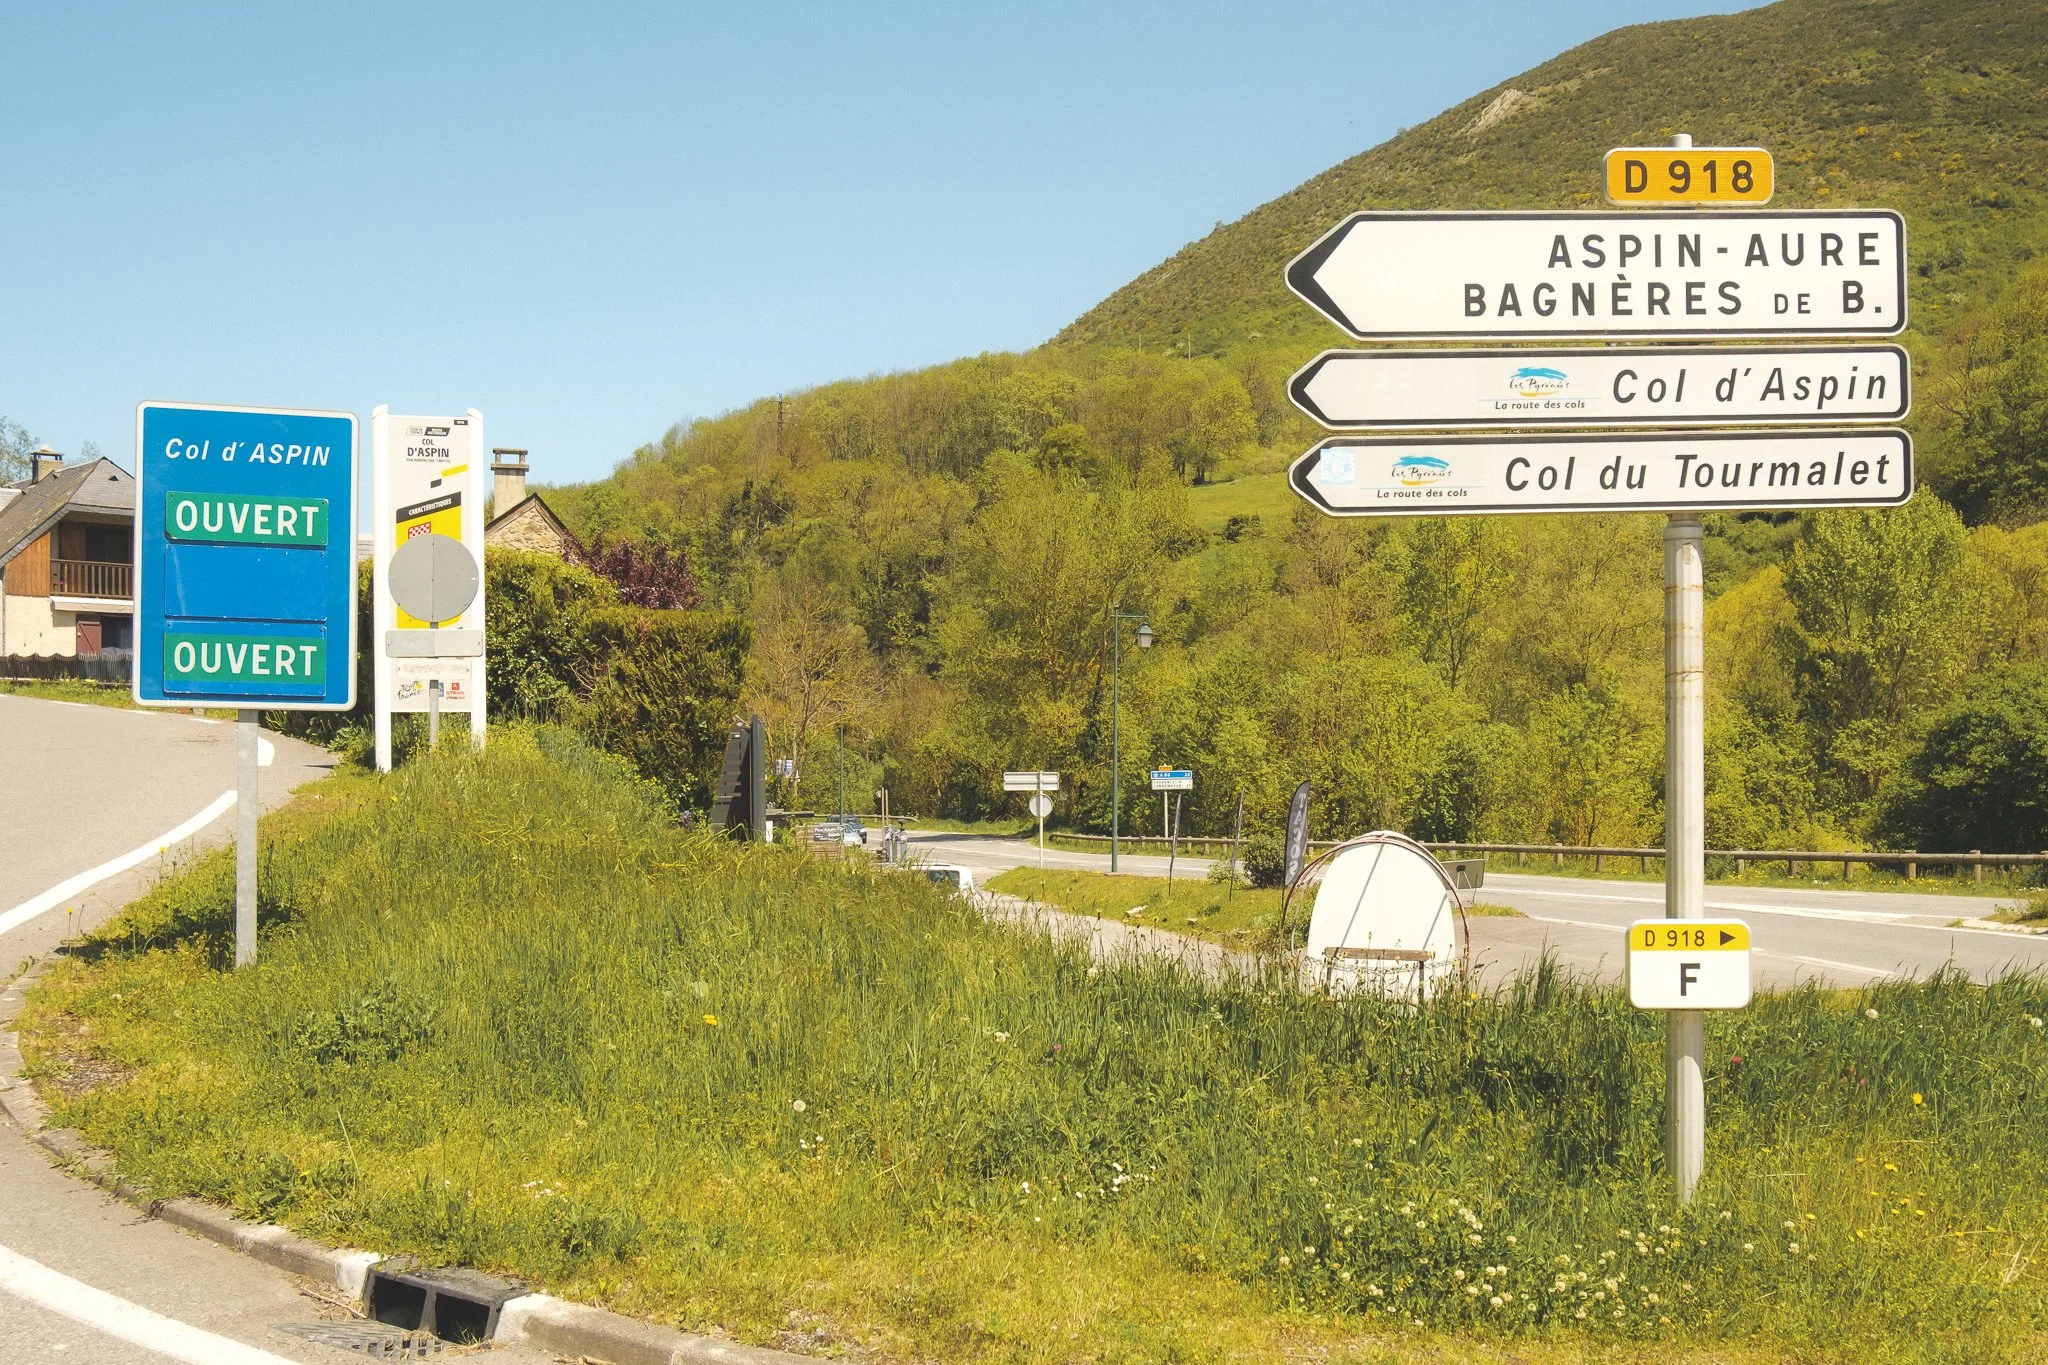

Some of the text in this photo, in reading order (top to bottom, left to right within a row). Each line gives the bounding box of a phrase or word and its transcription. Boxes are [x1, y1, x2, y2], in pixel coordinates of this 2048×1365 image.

[1625, 159, 1755, 194] D 918
[1548, 232, 1880, 269] ASPIN-AURE
[1464, 272, 1883, 317] BAGNÈRES DE B.
[1495, 399, 1585, 410] La route des cols
[1613, 366, 1887, 410] Col d'Aspin
[165, 437, 331, 467] Col d'ASPIN
[407, 447, 449, 458] D'ASPIN
[422, 438, 435, 446] COL
[1505, 451, 1890, 492] Col du Tourmalet
[408, 498, 452, 516] CARACTÉRISTIQUES
[1377, 488, 1468, 499] La route des cols
[175, 500, 320, 537] OUVERT
[173, 641, 318, 677] OUVERT
[1645, 930, 1705, 947] D 918
[1680, 963, 1700, 996] F
